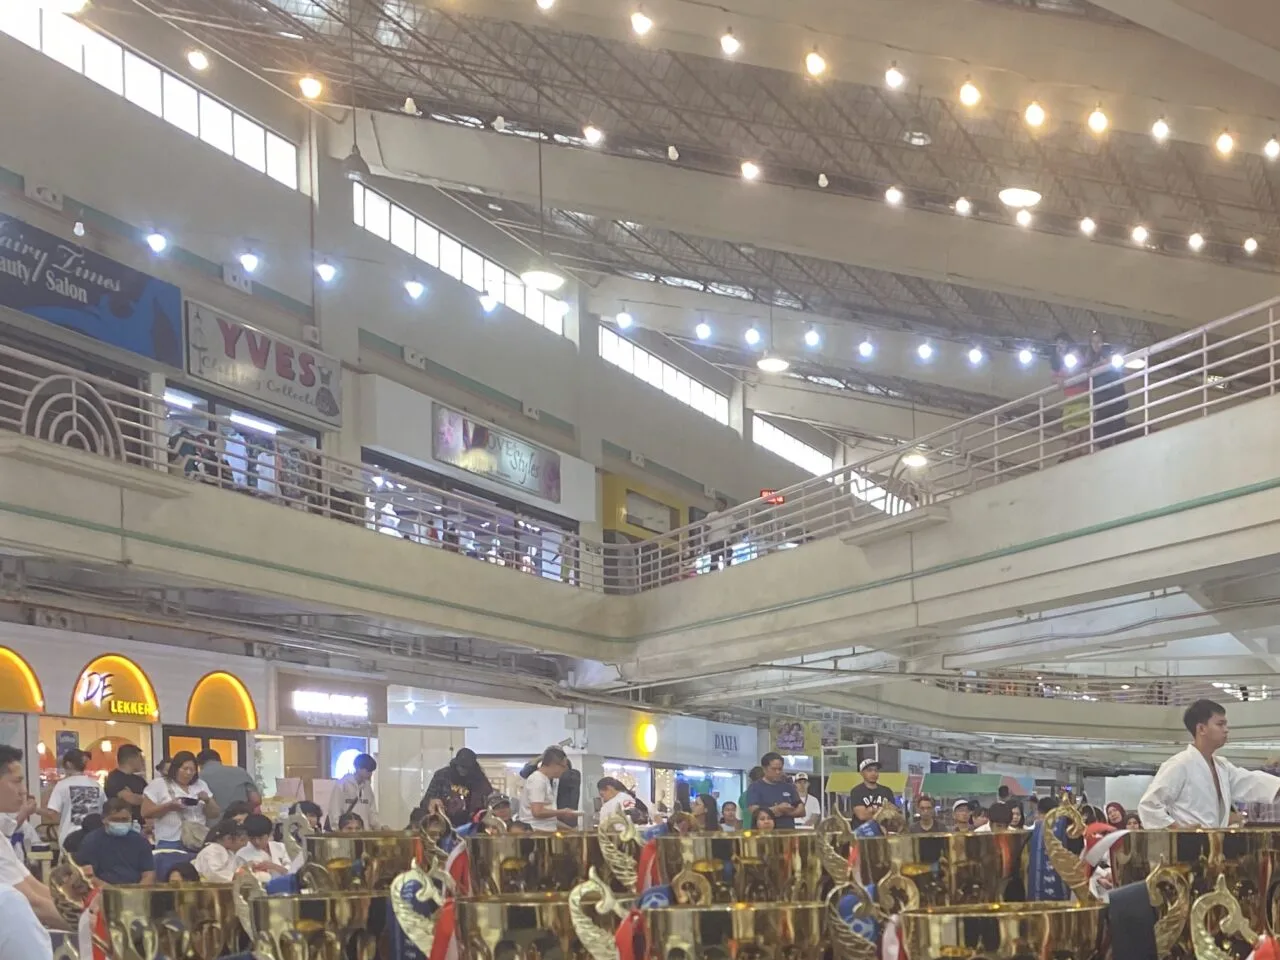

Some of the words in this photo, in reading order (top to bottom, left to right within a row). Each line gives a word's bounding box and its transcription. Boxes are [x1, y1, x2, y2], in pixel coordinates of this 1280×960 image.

[46, 269, 88, 304] Salon
[216, 318, 316, 387] YVES
[110, 700, 154, 715] LEKKER
